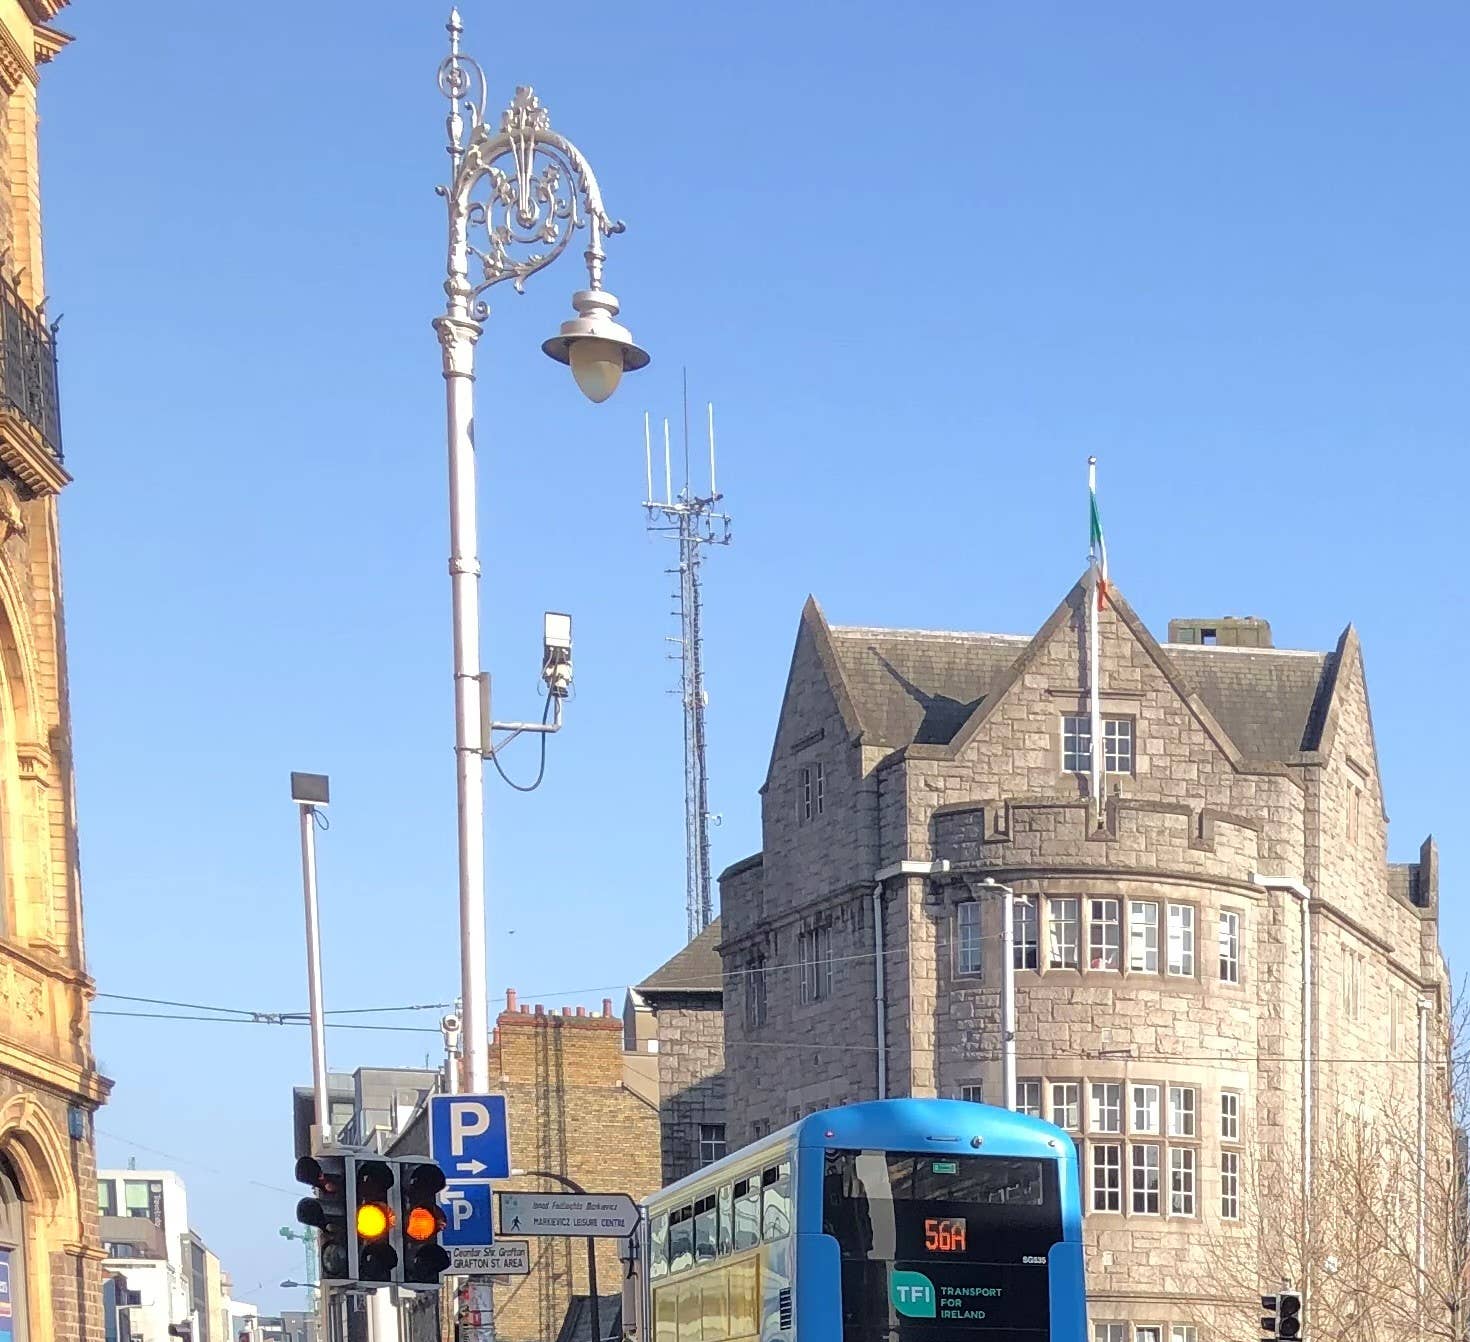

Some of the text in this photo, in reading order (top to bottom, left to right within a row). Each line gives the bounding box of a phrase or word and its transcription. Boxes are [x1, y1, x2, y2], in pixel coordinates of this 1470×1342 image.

[450, 1102, 490, 1156] P
[453, 1200, 473, 1230] P
[601, 1219, 625, 1227] CENTRE
[925, 1219, 966, 1251] 56A
[454, 1259, 488, 1268] GRAFTON
[504, 1259, 523, 1268] AREA
[897, 1286, 930, 1303] TFI
[941, 1287, 1002, 1297] TRANSPORT
[941, 1299, 962, 1307] FOR
[941, 1310, 986, 1319] IRELAND
